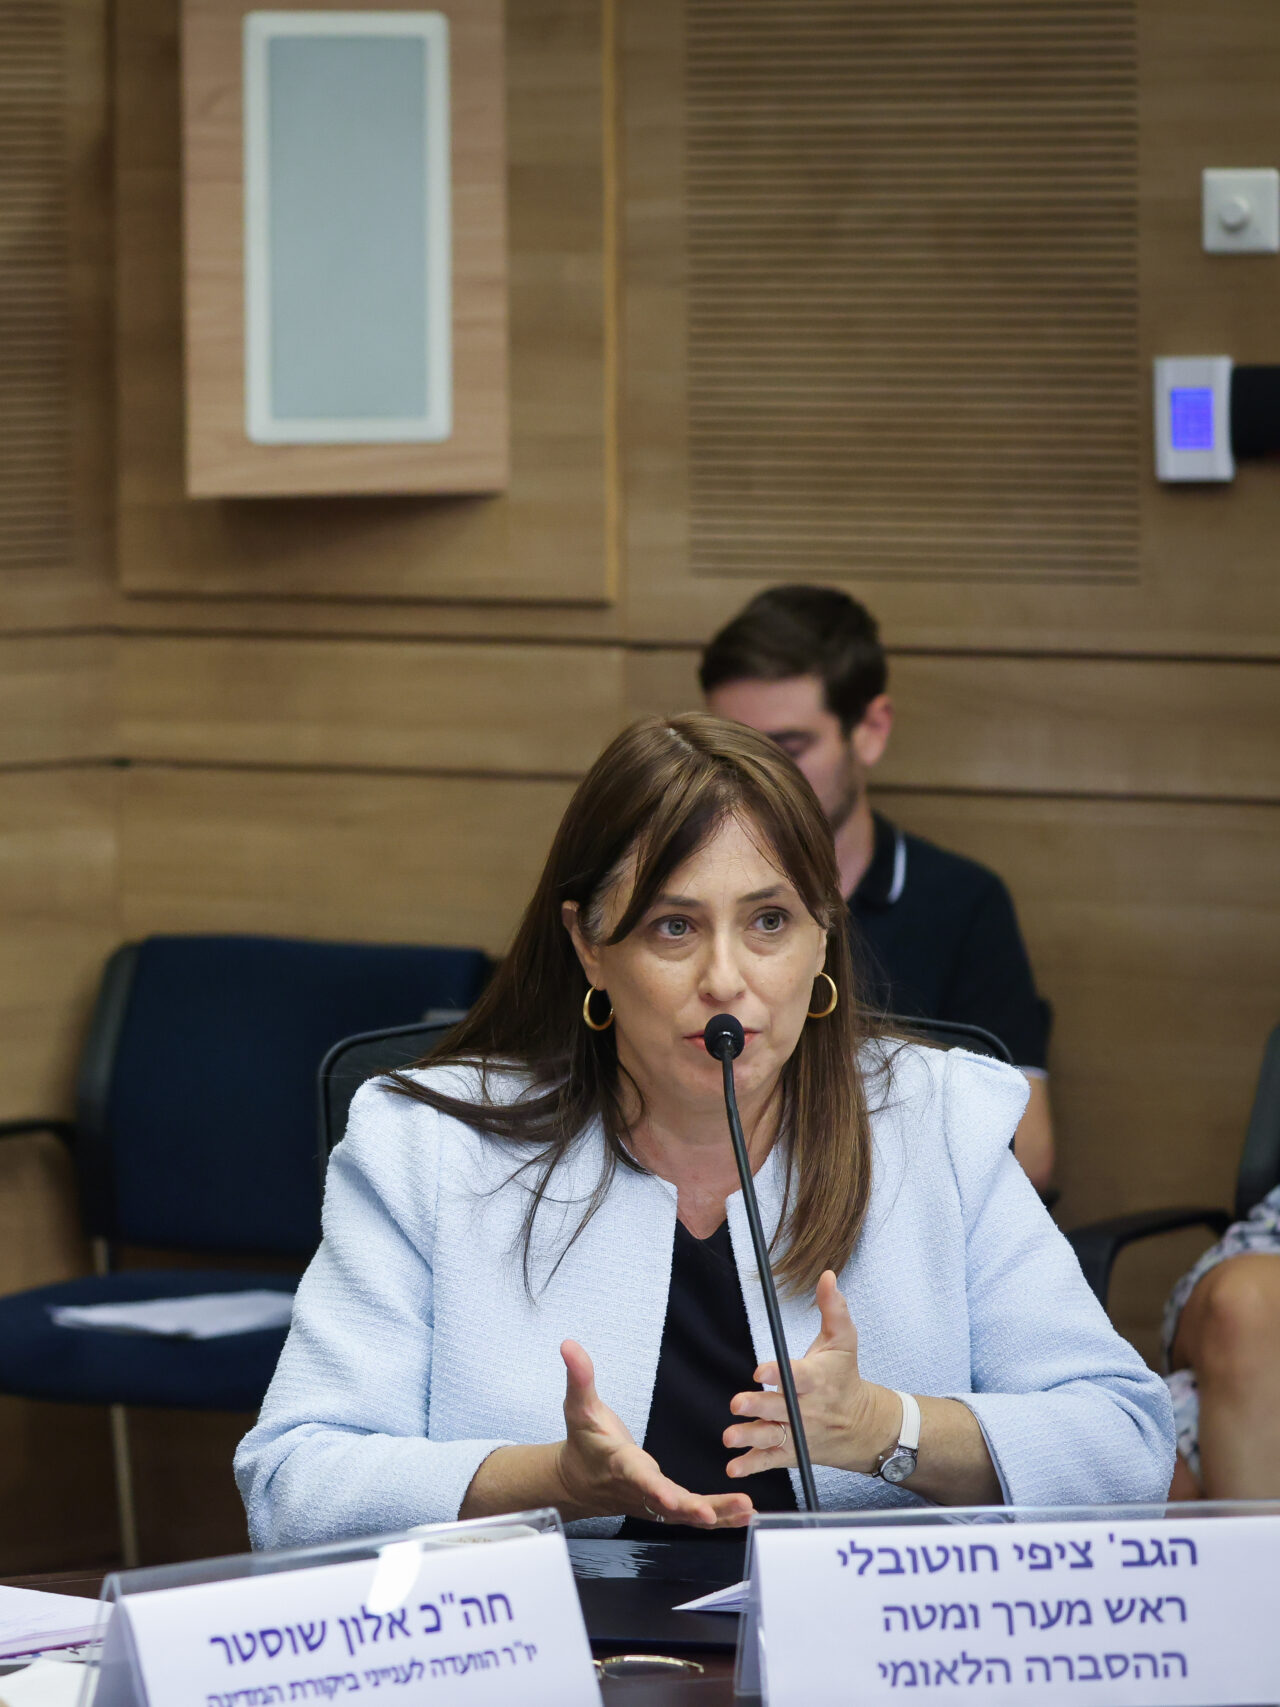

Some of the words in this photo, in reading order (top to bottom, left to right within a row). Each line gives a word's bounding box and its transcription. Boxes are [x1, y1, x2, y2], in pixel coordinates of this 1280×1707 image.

[836, 1540, 1000, 1577] חוטובלי
[1012, 1539, 1094, 1572] ציפי
[882, 1602, 980, 1633] ומטה
[991, 1599, 1093, 1637] מערך
[1103, 1596, 1188, 1625] ראש
[209, 1617, 328, 1666] שוסטר
[337, 1604, 413, 1657] אלון
[877, 1650, 1012, 1689] הלאומי
[1025, 1652, 1189, 1683] ההסברה
